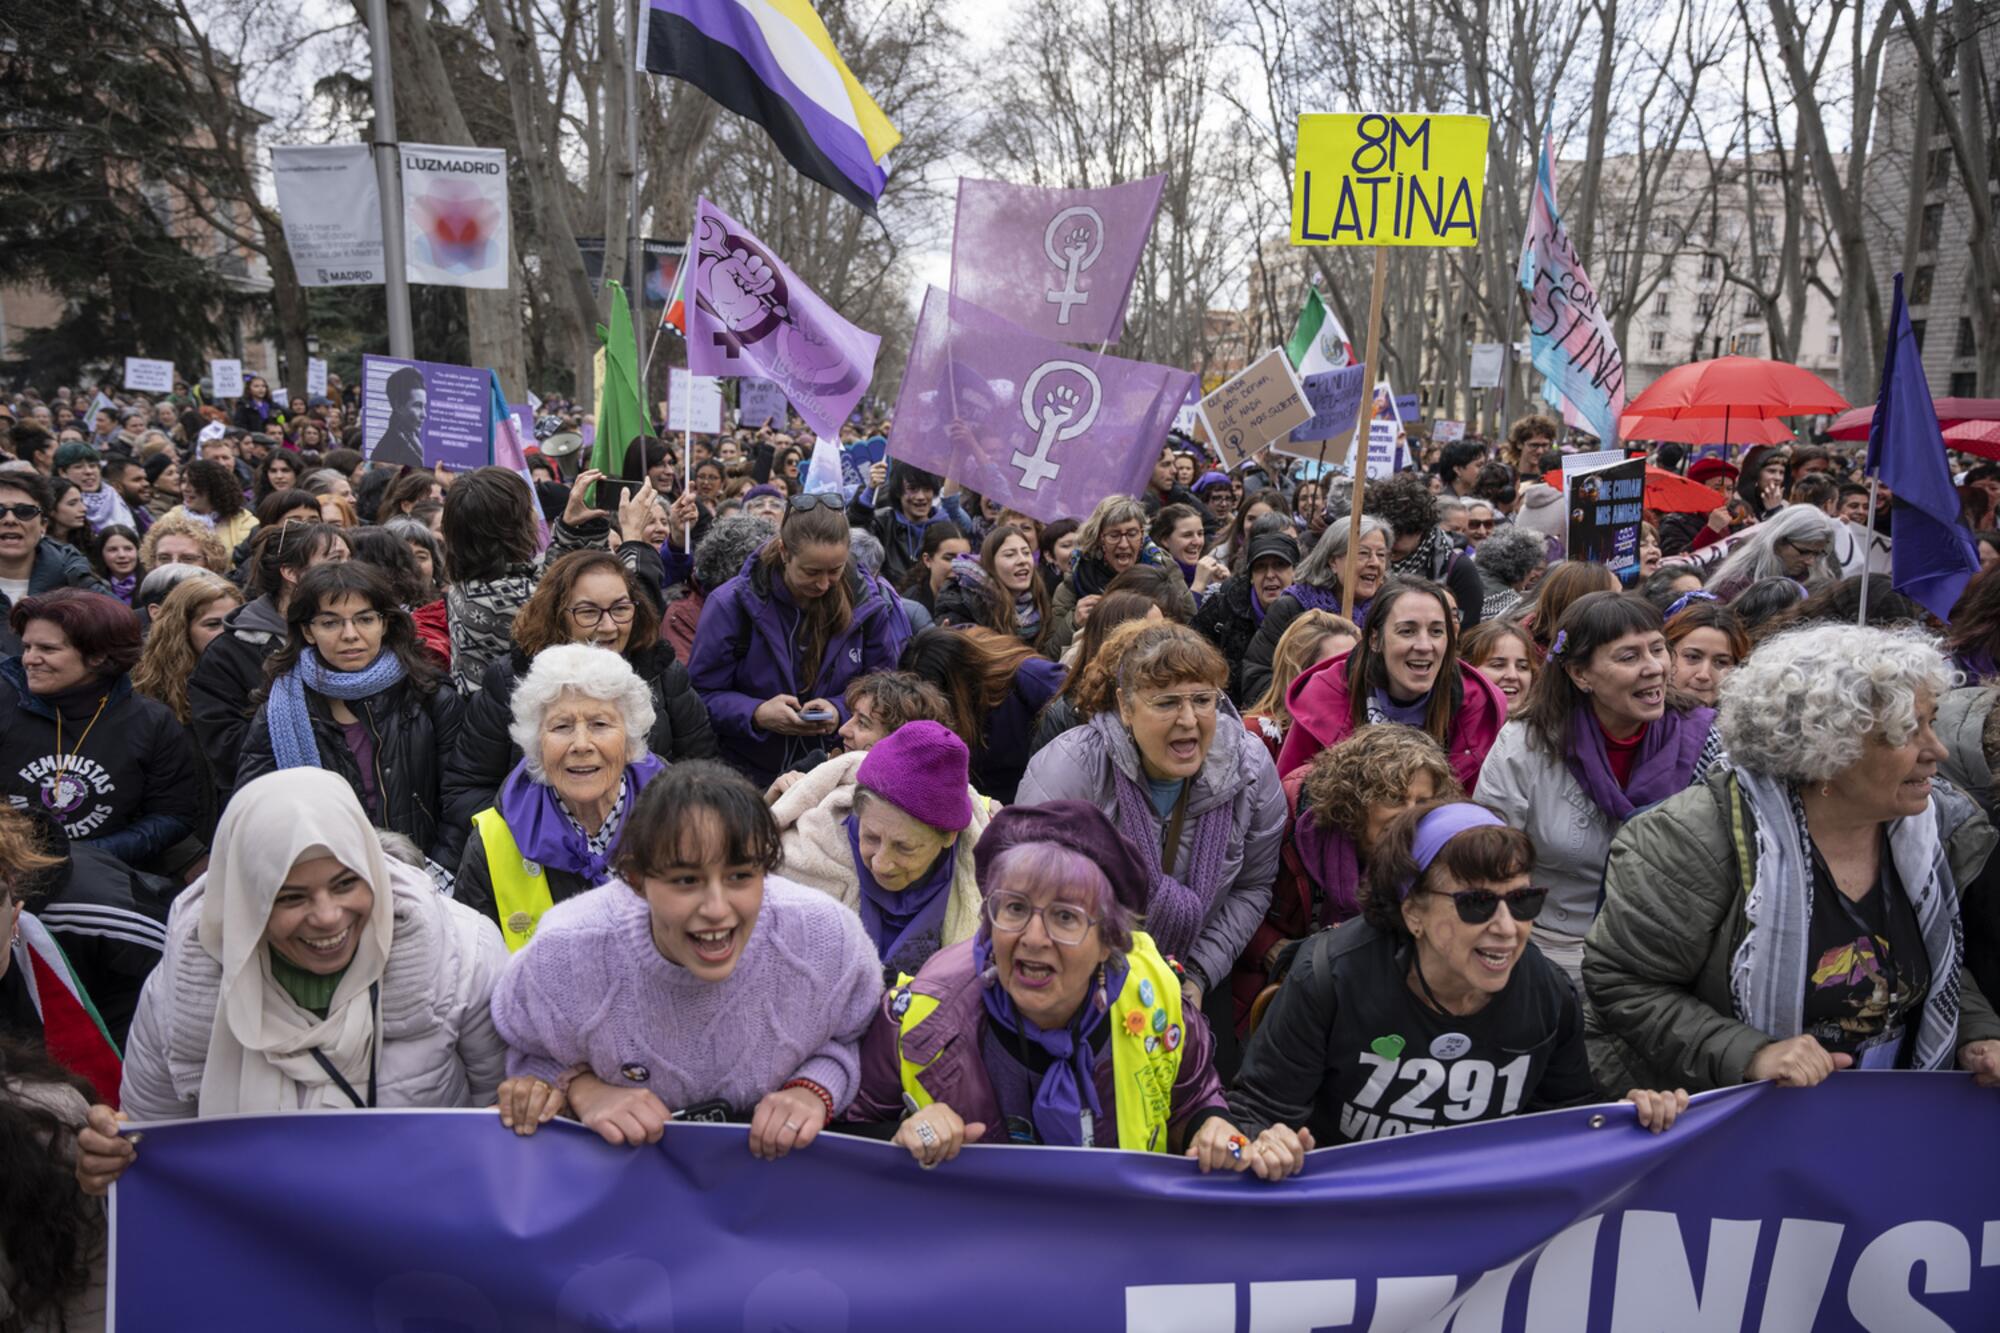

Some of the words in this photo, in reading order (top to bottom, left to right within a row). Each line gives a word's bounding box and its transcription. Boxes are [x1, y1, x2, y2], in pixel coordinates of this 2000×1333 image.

[1351, 114, 1431, 174] 8M
[406, 157, 500, 175] LUZMADRID
[330, 269, 373, 282] MADRID
[1560, 272, 1600, 314] CON
[1599, 480, 1613, 500] ME
[1595, 505, 1611, 526] MIS
[1611, 502, 1642, 524] AMIGAS
[18, 753, 115, 795] FEMINISTAS
[1353, 1051, 1531, 1120] 7291
